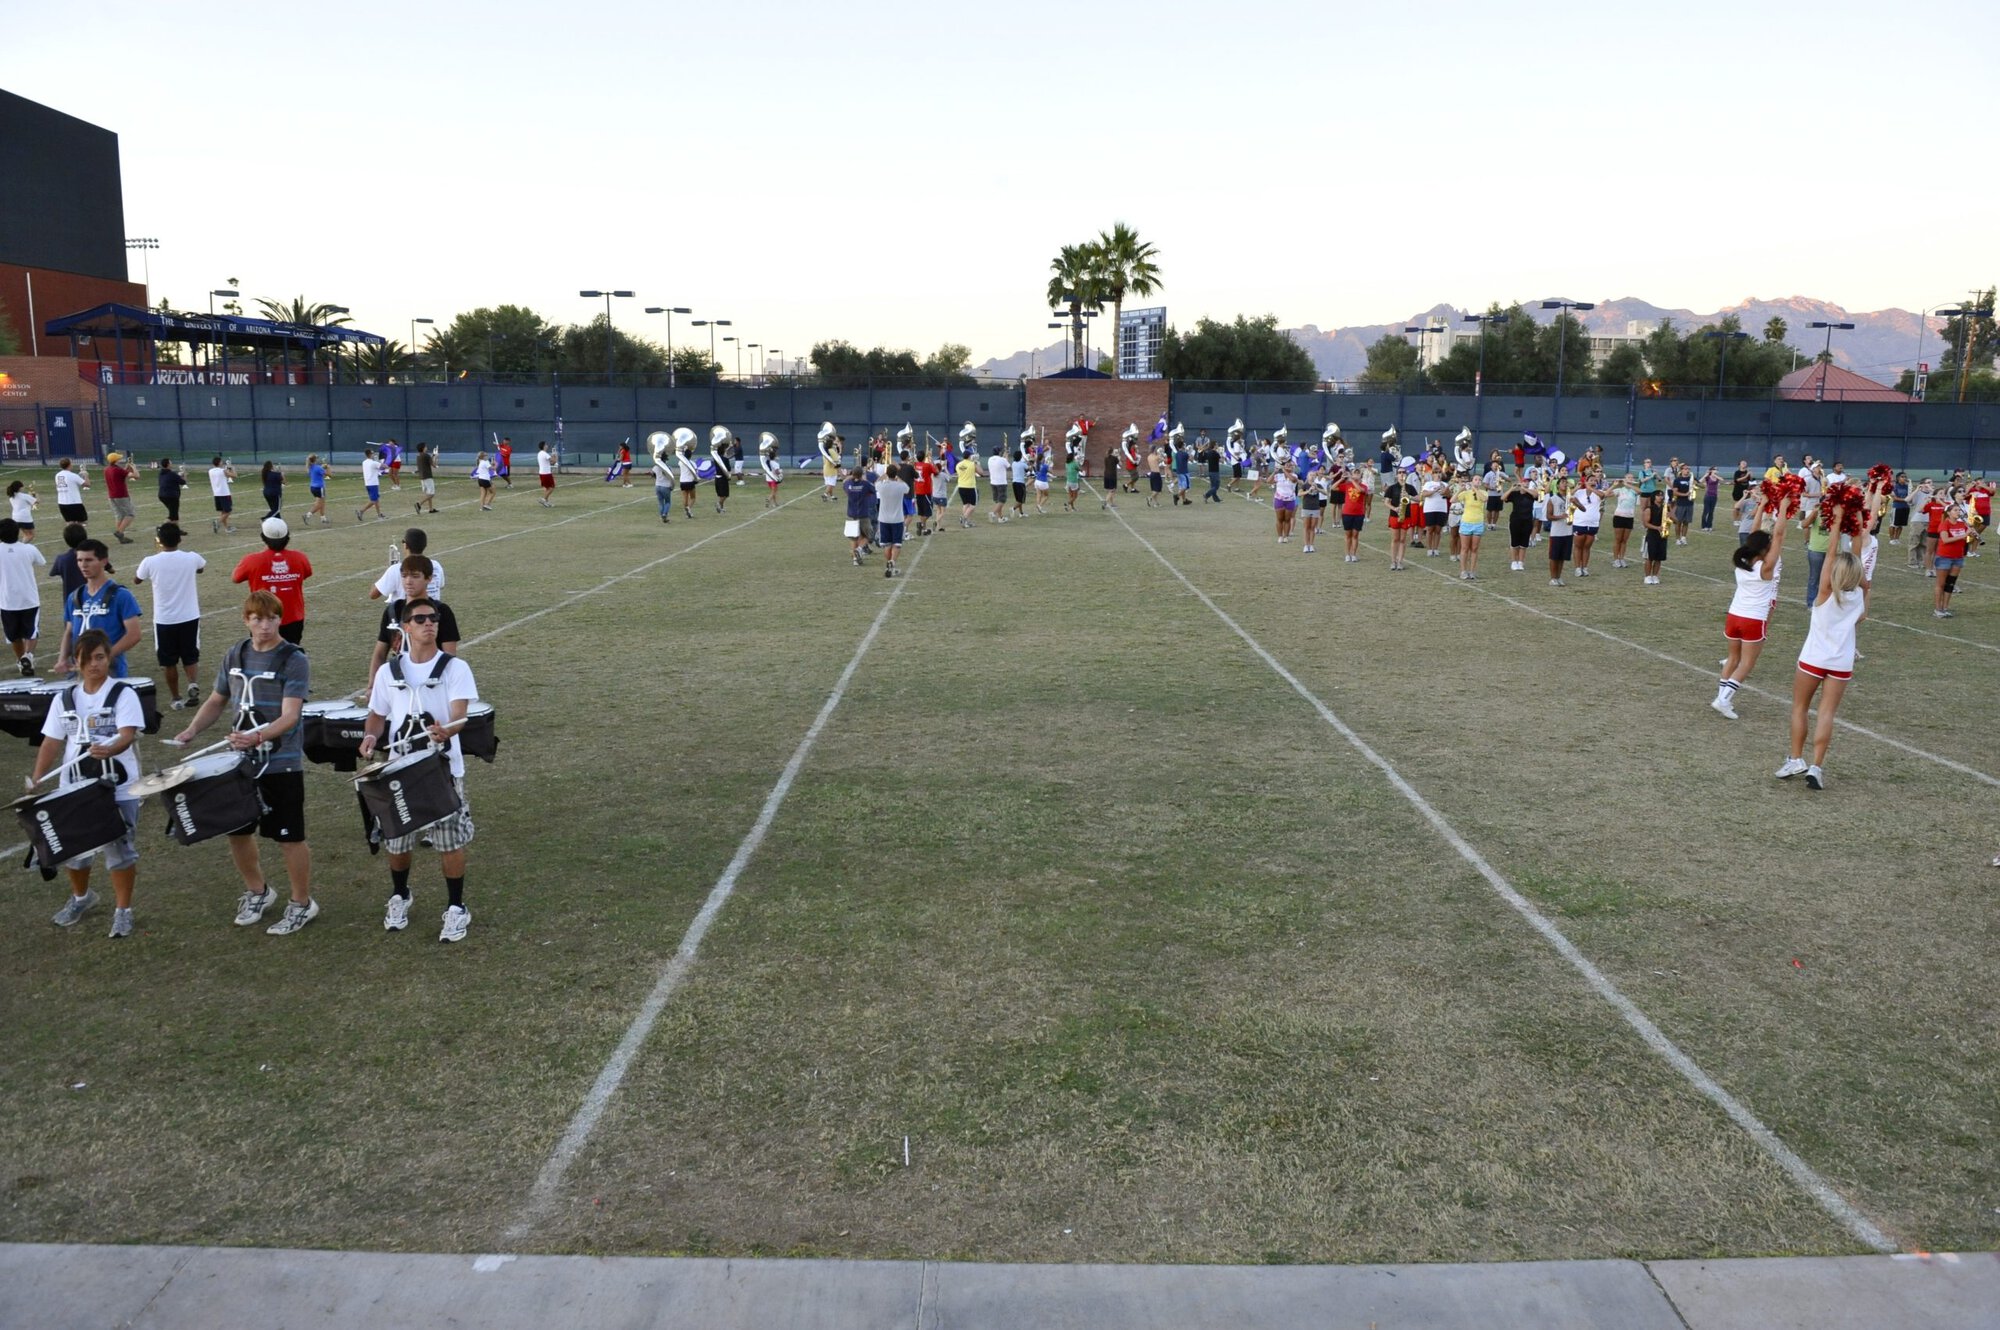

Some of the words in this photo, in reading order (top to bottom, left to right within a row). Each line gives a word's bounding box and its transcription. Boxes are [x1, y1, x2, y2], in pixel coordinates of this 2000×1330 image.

[161, 316, 174, 326] THE
[184, 322, 220, 330] UNIVERSTY
[229, 323, 237, 331] OF
[245, 325, 271, 333] ARIZONA
[365, 336, 380, 344] CENTER
[175, 801, 197, 837] YAMAHA
[394, 788, 412, 825] YAMAHA
[40, 819, 63, 855] YAMAHA
